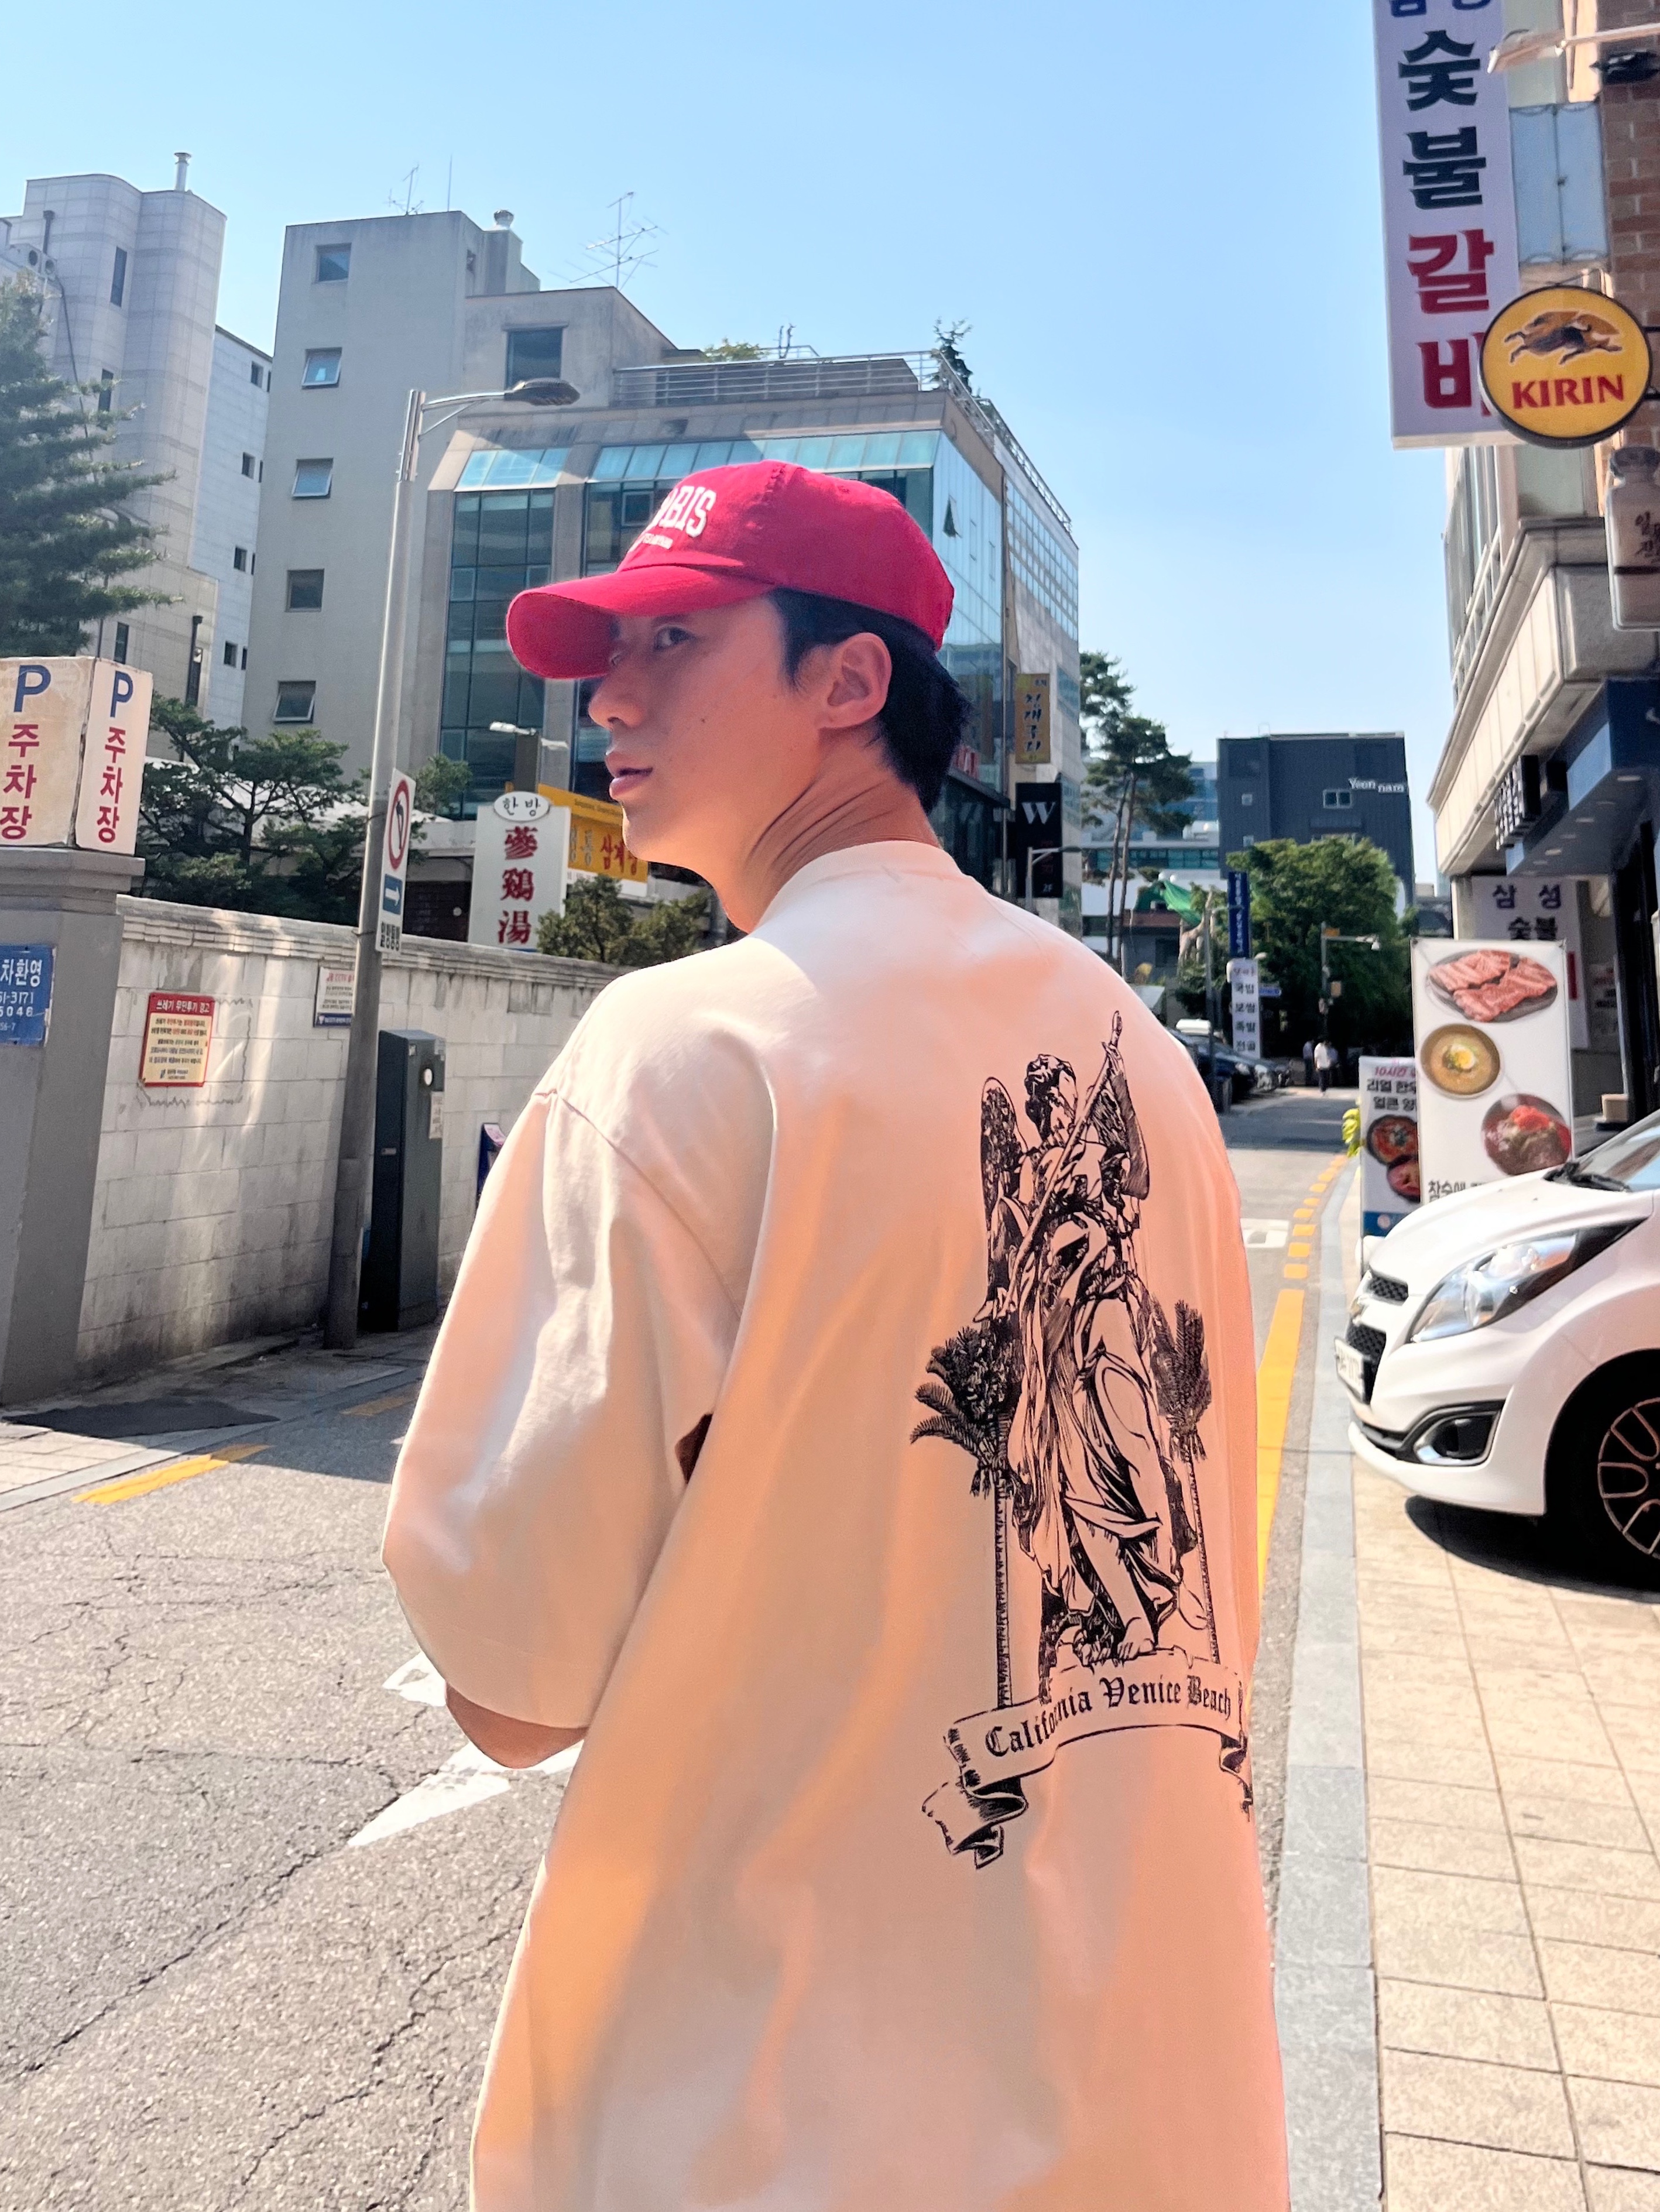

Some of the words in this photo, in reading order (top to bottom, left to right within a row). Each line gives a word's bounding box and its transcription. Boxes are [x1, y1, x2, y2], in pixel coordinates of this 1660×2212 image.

[1511, 373, 1625, 410] KIRIN
[13, 664, 51, 712] P
[110, 670, 133, 718] P
[0, 724, 39, 839] 주차장
[97, 726, 126, 843] 주차장
[502, 797, 540, 817] 한방
[1022, 802, 1056, 825] W
[985, 1687, 1092, 1757] California
[1099, 1674, 1181, 1708] Venice
[1186, 1675, 1231, 1720] Beach
